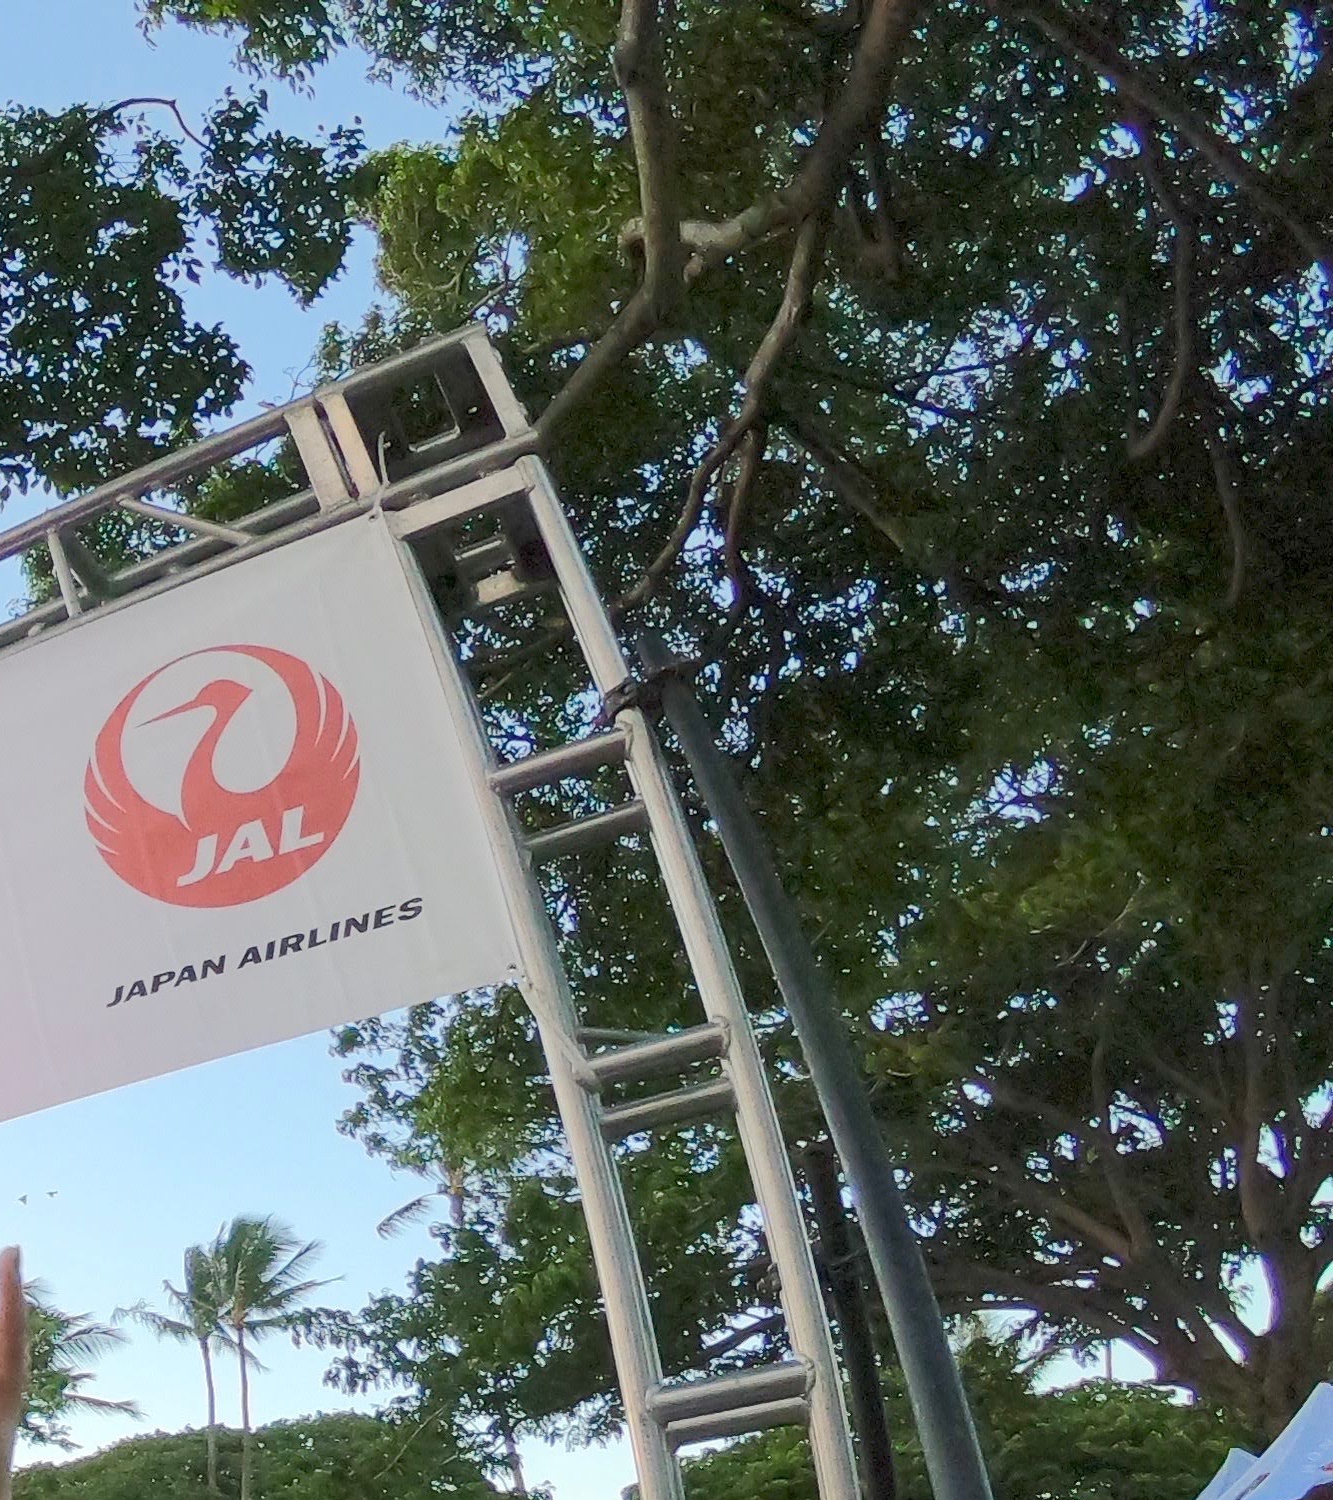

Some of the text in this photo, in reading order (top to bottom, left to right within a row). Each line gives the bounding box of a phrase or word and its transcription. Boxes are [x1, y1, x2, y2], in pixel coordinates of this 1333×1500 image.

[177, 806, 324, 888] JAL
[106, 897, 424, 1008] JAPAN AIRLINES
